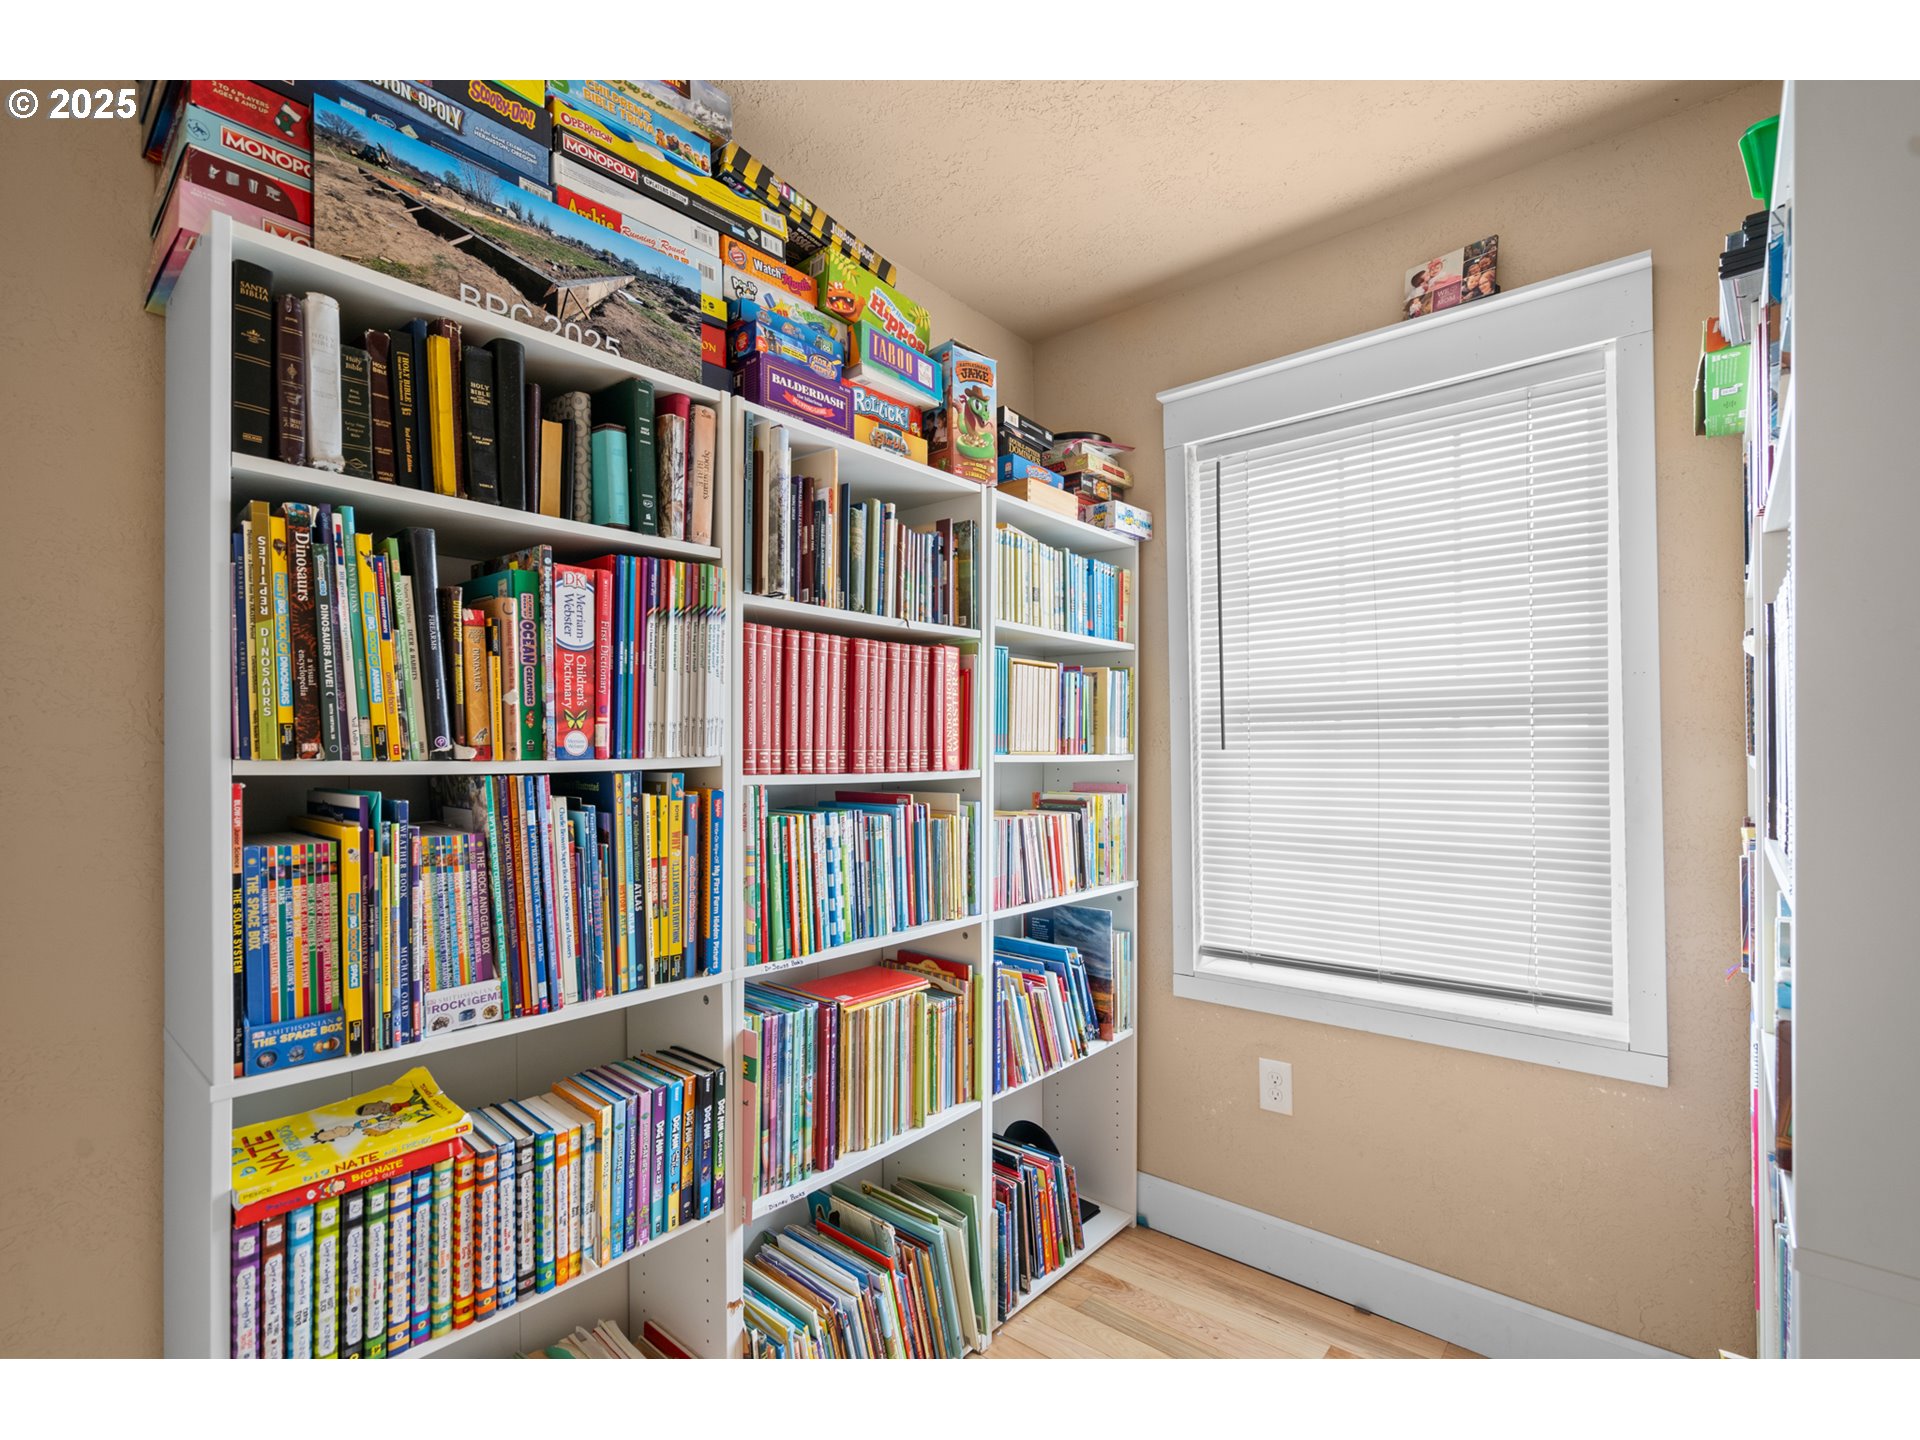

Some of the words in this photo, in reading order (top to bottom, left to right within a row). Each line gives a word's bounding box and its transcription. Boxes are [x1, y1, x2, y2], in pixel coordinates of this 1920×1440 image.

[212, 87, 233, 100] AGES
[241, 100, 256, 110] AND
[258, 106, 269, 114] UP
[218, 82, 230, 92] TO
[238, 91, 270, 109] PLAYERS
[469, 80, 536, 128] SCOOBY-DOO!
[586, 80, 652, 123] CHILDREN'S
[418, 90, 462, 130] OPOLY
[582, 88, 616, 114] BIBLE
[618, 106, 656, 135] TRIVIA
[560, 112, 613, 145] OPERATION
[565, 139, 636, 181] MONOPOLY
[620, 226, 656, 246] Running
[752, 258, 782, 278] Watch
[240, 280, 268, 296] SANTA
[240, 288, 268, 302] BIBLIA
[345, 355, 362, 364] Holy
[372, 361, 387, 370] HOLY
[872, 334, 913, 375] TABOO
[372, 366, 387, 376] BIBLE
[402, 357, 410, 378] HOLY
[961, 368, 989, 383] JAKE
[404, 379, 412, 402] BIBLE
[470, 382, 490, 391] HOLY
[470, 388, 491, 398] BIBLE
[772, 373, 844, 410] BALDERDASH
[294, 532, 311, 602] Dinosaurs
[565, 572, 586, 586] DK
[276, 574, 286, 598] FIRST
[338, 582, 347, 598] great
[348, 562, 358, 613] INVENTIONS
[277, 599, 287, 614] BIG
[364, 592, 374, 615] FIRST
[454, 600, 462, 620] DINO
[564, 593, 576, 636] Webster
[278, 616, 288, 640] BOOK
[366, 616, 375, 630] BIG
[575, 593, 586, 642] Merriam-
[320, 604, 330, 657] DINOSAURS
[408, 628, 416, 646] DEER
[428, 614, 438, 651] FIREARMS
[454, 622, 464, 642] POOP
[522, 621, 536, 664] OCEAN
[600, 620, 610, 642] First
[279, 642, 289, 654] OF
[368, 632, 378, 654] BOOK
[260, 628, 272, 717] DINOSAURS
[298, 649, 308, 697] encyclopedia
[322, 658, 333, 688] ALIVE!
[370, 656, 378, 668] OF
[410, 654, 418, 680] RABBITS
[472, 647, 482, 692] DINOSAURS
[598, 645, 610, 694] Dictionary
[280, 656, 291, 706] DINOSAURS
[308, 665, 316, 686] visual
[371, 668, 382, 703] ANIMALS
[526, 667, 534, 705] CREATURES
[562, 653, 574, 709] Dictionary
[576, 654, 588, 706] Children's
[400, 824, 408, 870] WEATHER
[476, 850, 486, 868] THE
[560, 850, 568, 869] Super
[712, 865, 720, 876] My
[246, 875, 258, 896] THE
[400, 872, 408, 898] BOOK
[478, 870, 486, 895] ROCK
[562, 868, 570, 886] Book
[233, 888, 242, 905] THE
[349, 893, 358, 914] FIRST
[562, 892, 572, 918] Questions
[634, 882, 643, 912] ATLAS
[672, 882, 681, 905] ANSWERS
[248, 897, 260, 928] SPACE
[479, 896, 487, 916] AND
[233, 906, 242, 934] SOLAR
[350, 915, 358, 928] BIG
[480, 916, 488, 934] GEM
[672, 914, 682, 944] EVERYTHING
[712, 916, 720, 940] Hidden
[248, 930, 260, 951] BOX
[350, 929, 359, 951] BOOK
[481, 937, 490, 955] BOX
[234, 938, 242, 974] SYSTEM
[400, 946, 408, 988] MICHAEL
[712, 941, 720, 969] Pictures
[772, 962, 789, 971] Seuss
[350, 964, 360, 988] SPACE
[430, 1000, 467, 1016] ROCK
[252, 1036, 278, 1048] THE
[280, 1028, 318, 1044] SPACE
[320, 1022, 344, 1037] BOX
[334, 1150, 380, 1174] NATE
[372, 1158, 404, 1174] NATE
